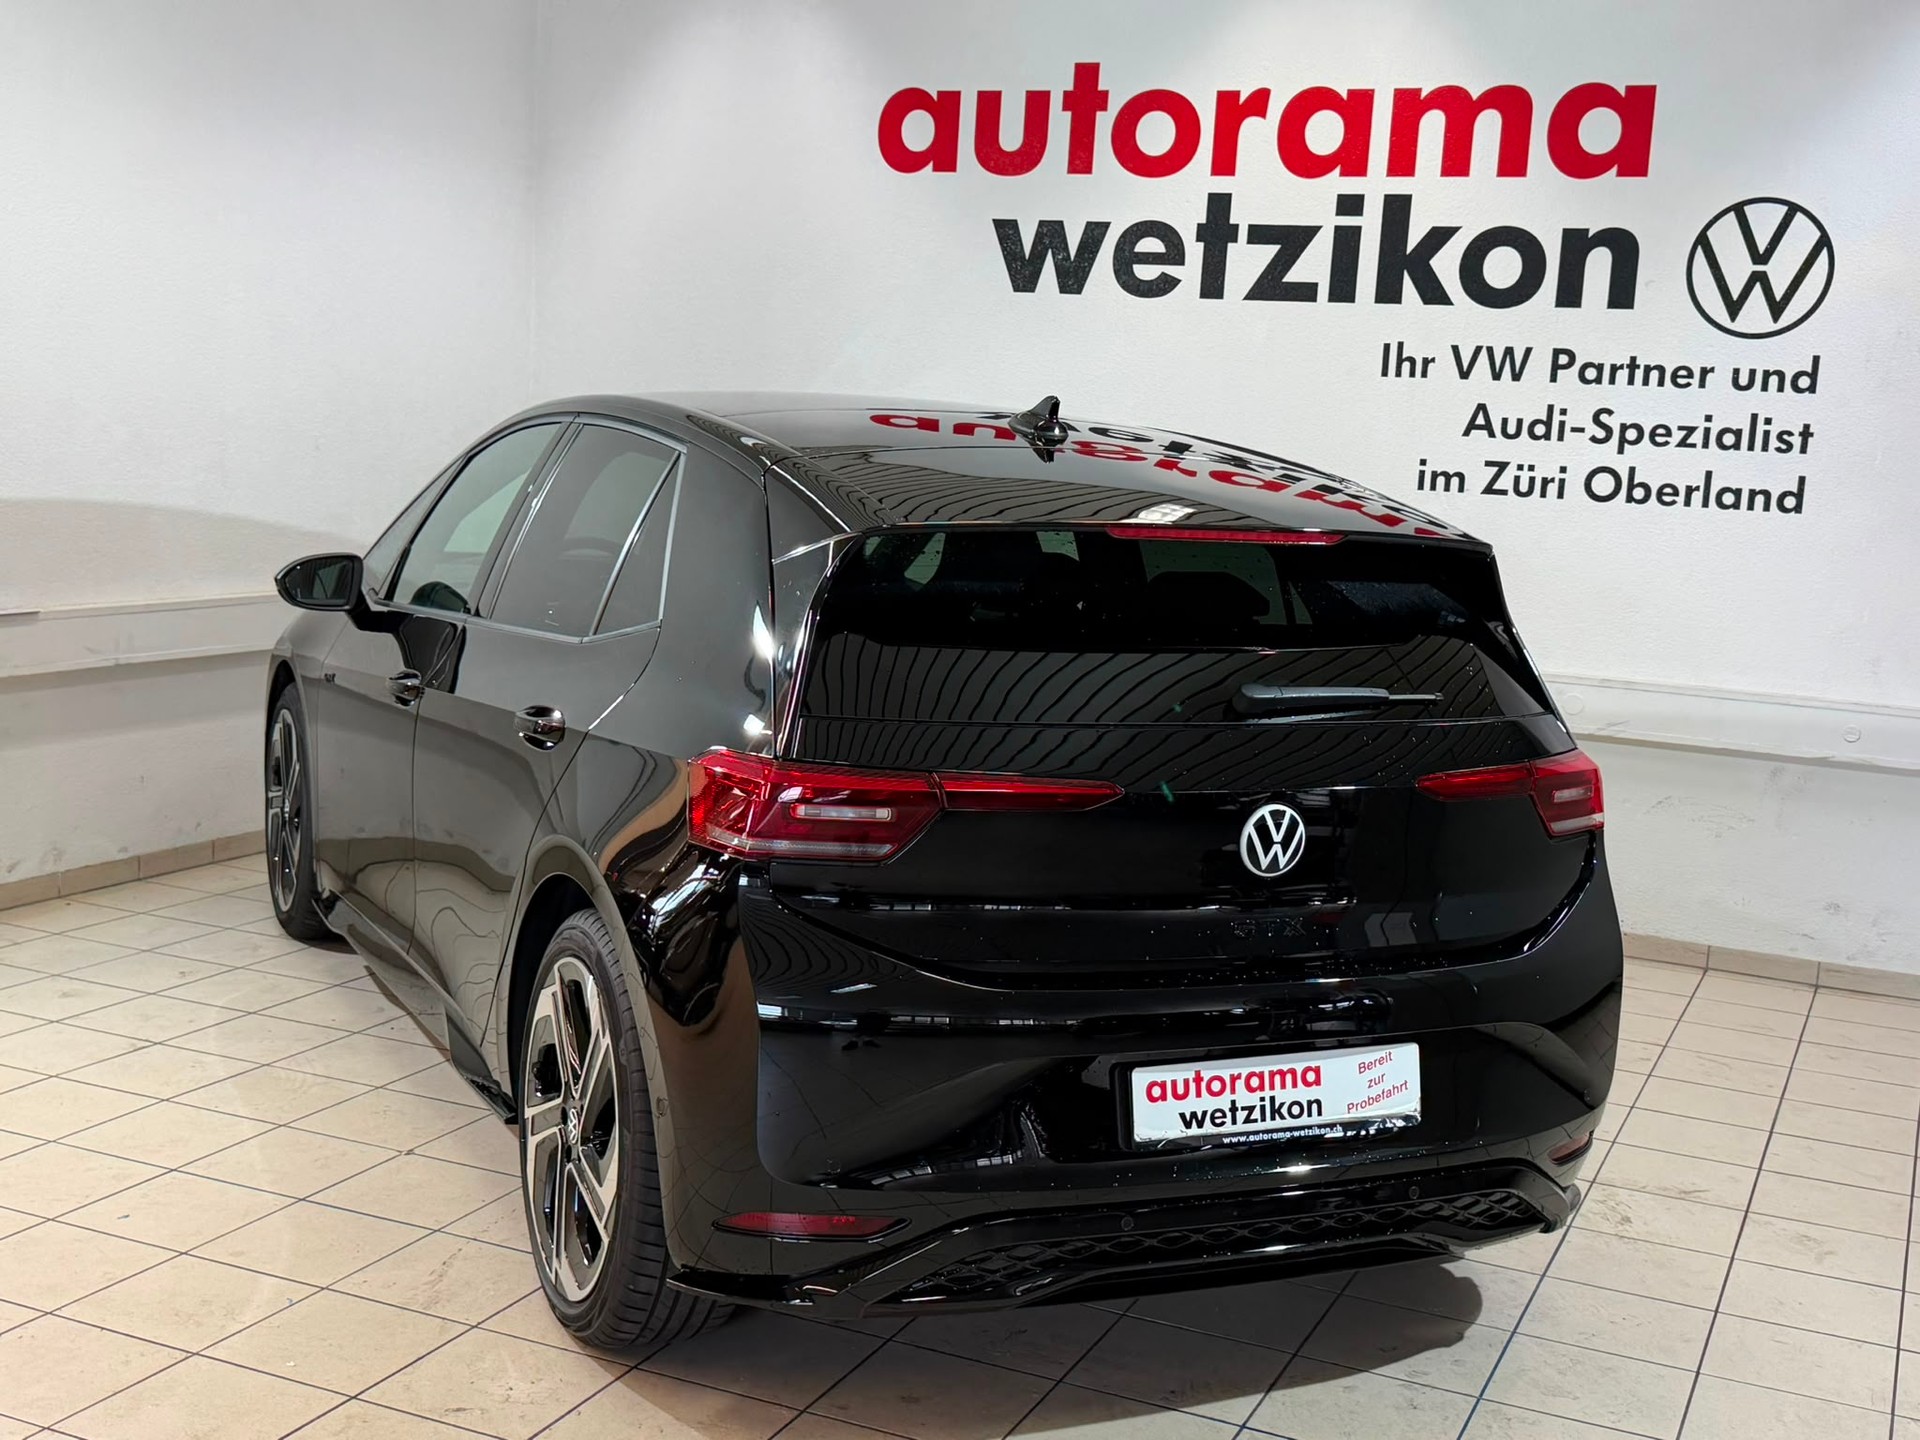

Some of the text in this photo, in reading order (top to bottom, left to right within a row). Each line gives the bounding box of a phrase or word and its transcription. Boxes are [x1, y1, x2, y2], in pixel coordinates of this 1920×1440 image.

[878, 62, 1658, 180] autorama
[992, 192, 1640, 310] wetzikon
[1380, 342, 1821, 395] Ihr VW Partner und
[1461, 402, 1815, 455] Audi-Spezialist
[1417, 458, 1807, 515] im Züri Oberland
[1357, 1050, 1393, 1075] Bereit
[1367, 1072, 1386, 1089] zur
[1145, 1065, 1323, 1104] autorama
[1346, 1079, 1409, 1114] Probefahrt
[1178, 1095, 1324, 1130] wetzikon
[1222, 1124, 1343, 1144] www.autorama-wetzikon.ch
